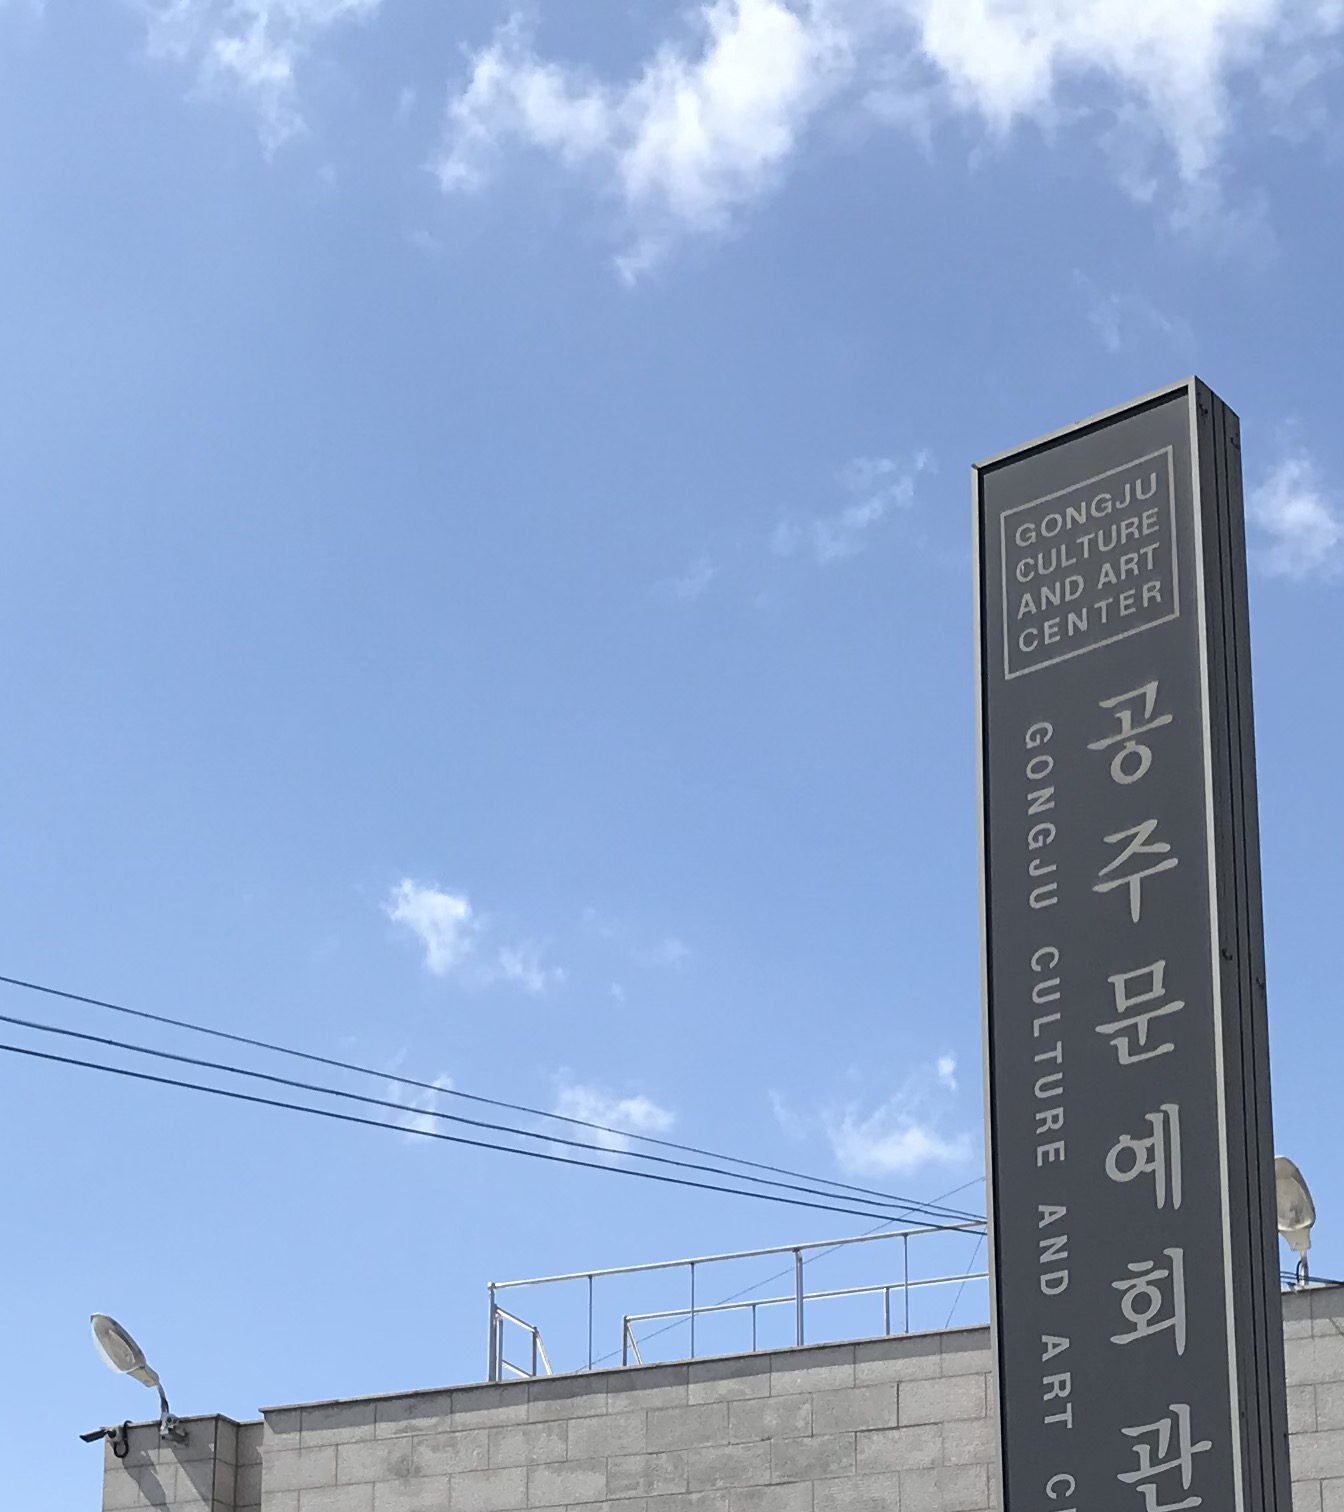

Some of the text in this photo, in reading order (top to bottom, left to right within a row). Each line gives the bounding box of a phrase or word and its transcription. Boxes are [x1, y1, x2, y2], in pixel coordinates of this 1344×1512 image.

[1015, 472, 1157, 547] GONGJU
[1016, 508, 1160, 583] CULTURE
[1017, 542, 1160, 620] AND ART
[1018, 580, 1162, 652] CENTER
[1025, 721, 1058, 910] GONGJU
[1030, 946, 1066, 1168] CULTURE
[1037, 1204, 1069, 1296] AND
[1040, 1333, 1073, 1429] ART
